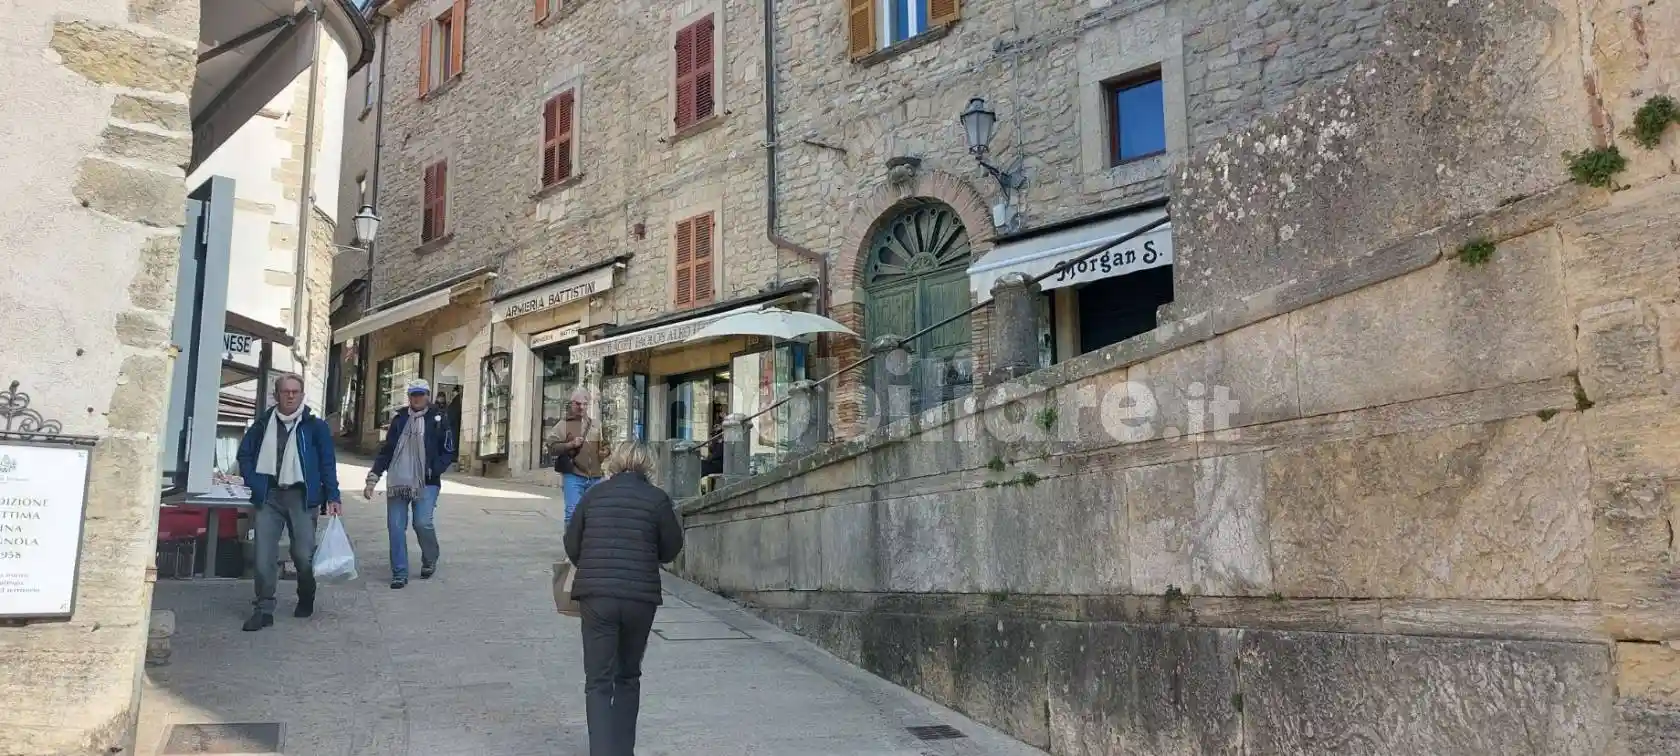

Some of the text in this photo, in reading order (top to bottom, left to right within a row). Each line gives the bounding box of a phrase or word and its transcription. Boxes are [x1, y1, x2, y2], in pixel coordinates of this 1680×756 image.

[1055, 240, 1163, 282] Morgan S.
[549, 281, 596, 305] BATTISTINI
